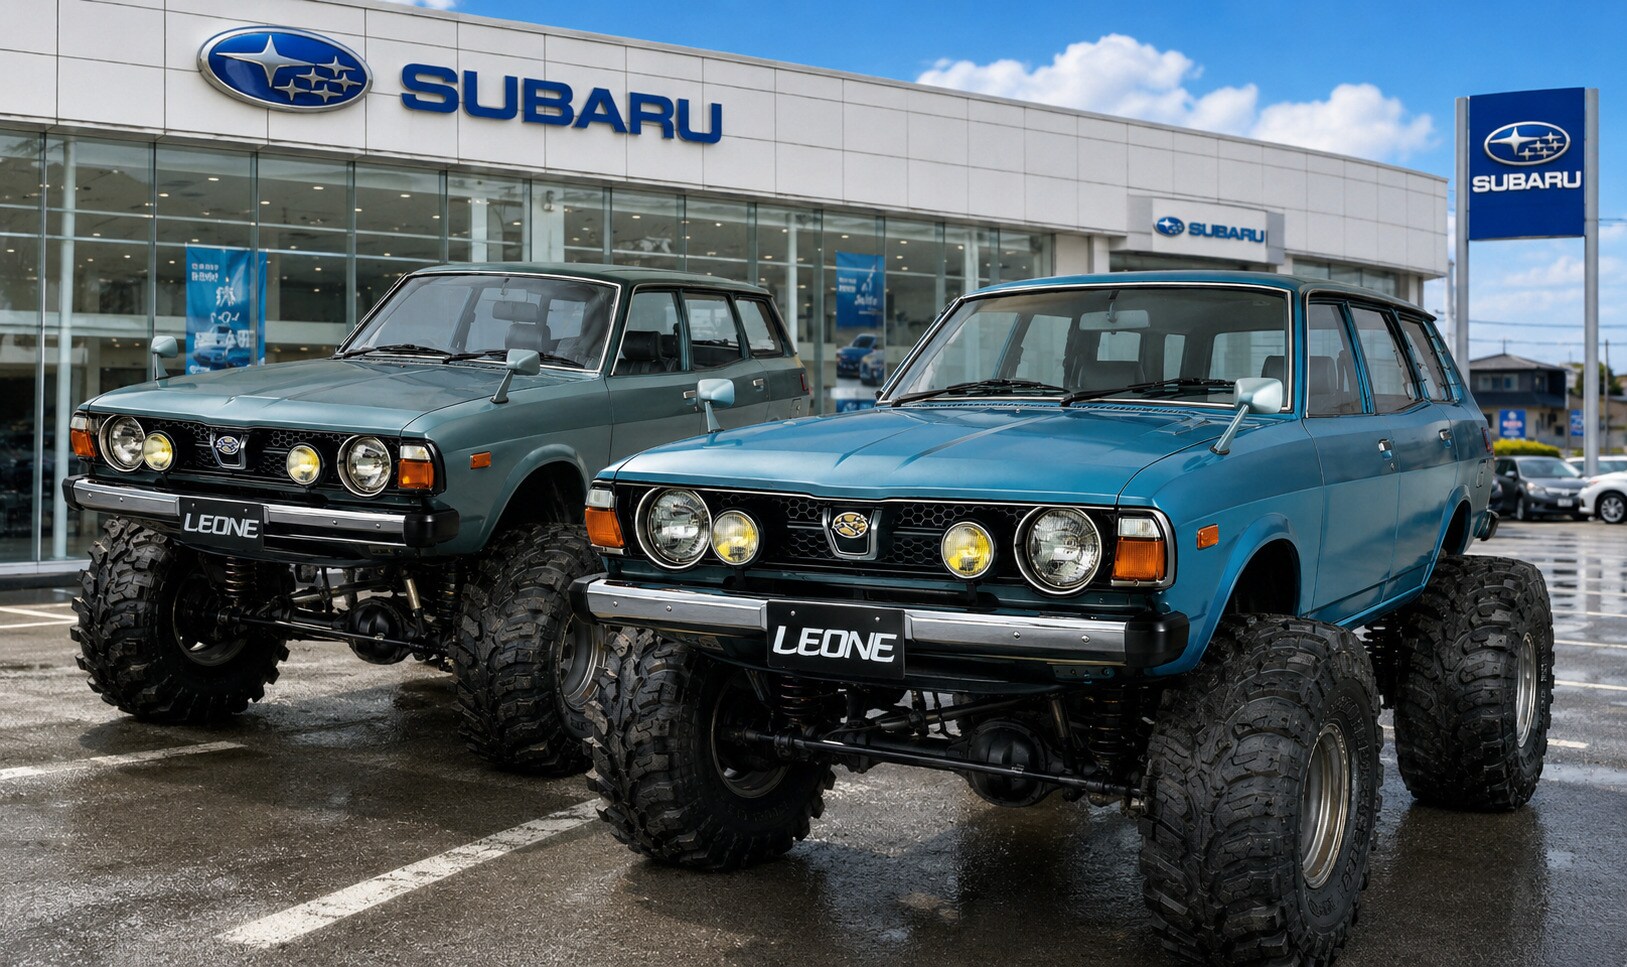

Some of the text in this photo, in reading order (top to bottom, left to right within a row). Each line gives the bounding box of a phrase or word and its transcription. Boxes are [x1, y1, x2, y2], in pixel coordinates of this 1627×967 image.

[401, 63, 722, 144] SUBARU
[1472, 171, 1582, 193] SUBARU
[1188, 222, 1265, 243] SUBARU
[183, 512, 260, 539] LEONE
[772, 625, 898, 663] LEONE
